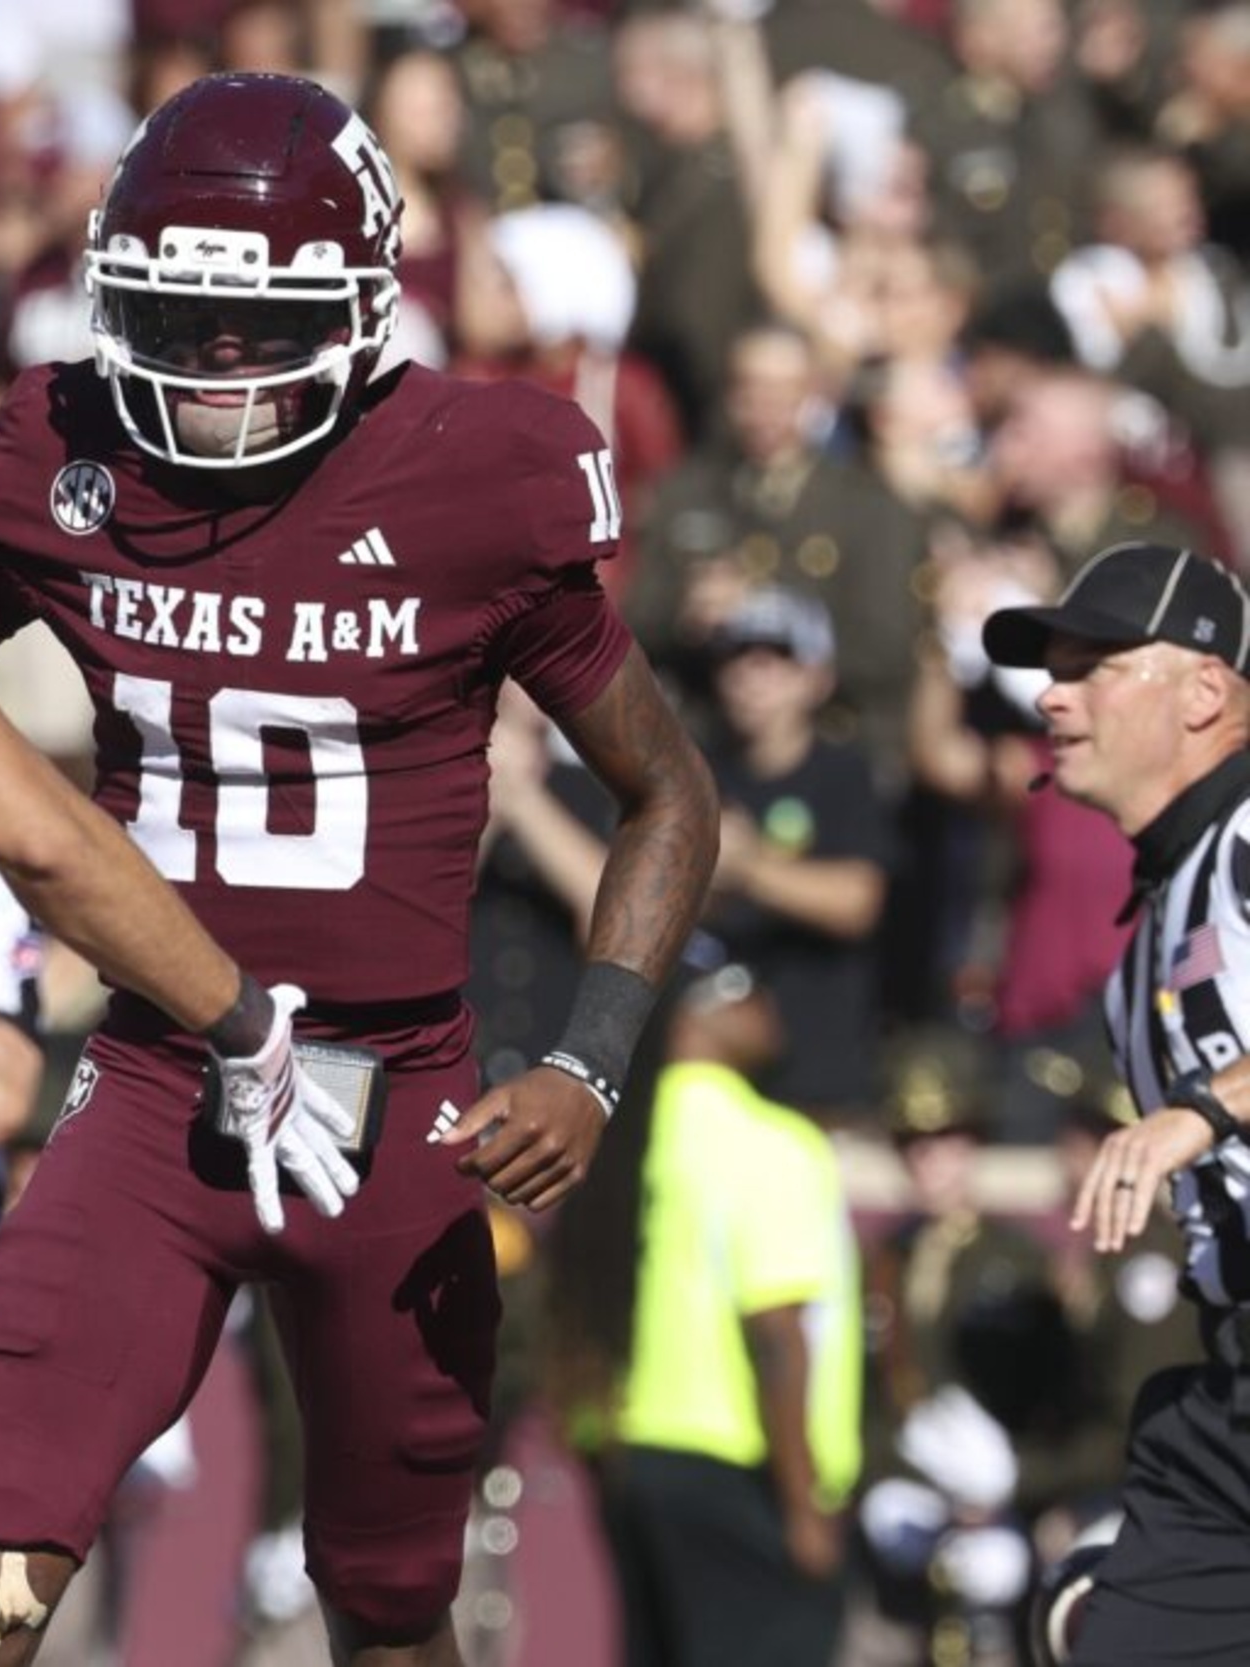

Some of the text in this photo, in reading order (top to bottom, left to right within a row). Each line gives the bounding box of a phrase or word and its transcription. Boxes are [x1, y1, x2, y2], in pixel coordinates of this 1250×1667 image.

[79, 571, 422, 662] TEXAS A&M
[113, 672, 369, 890] 10
